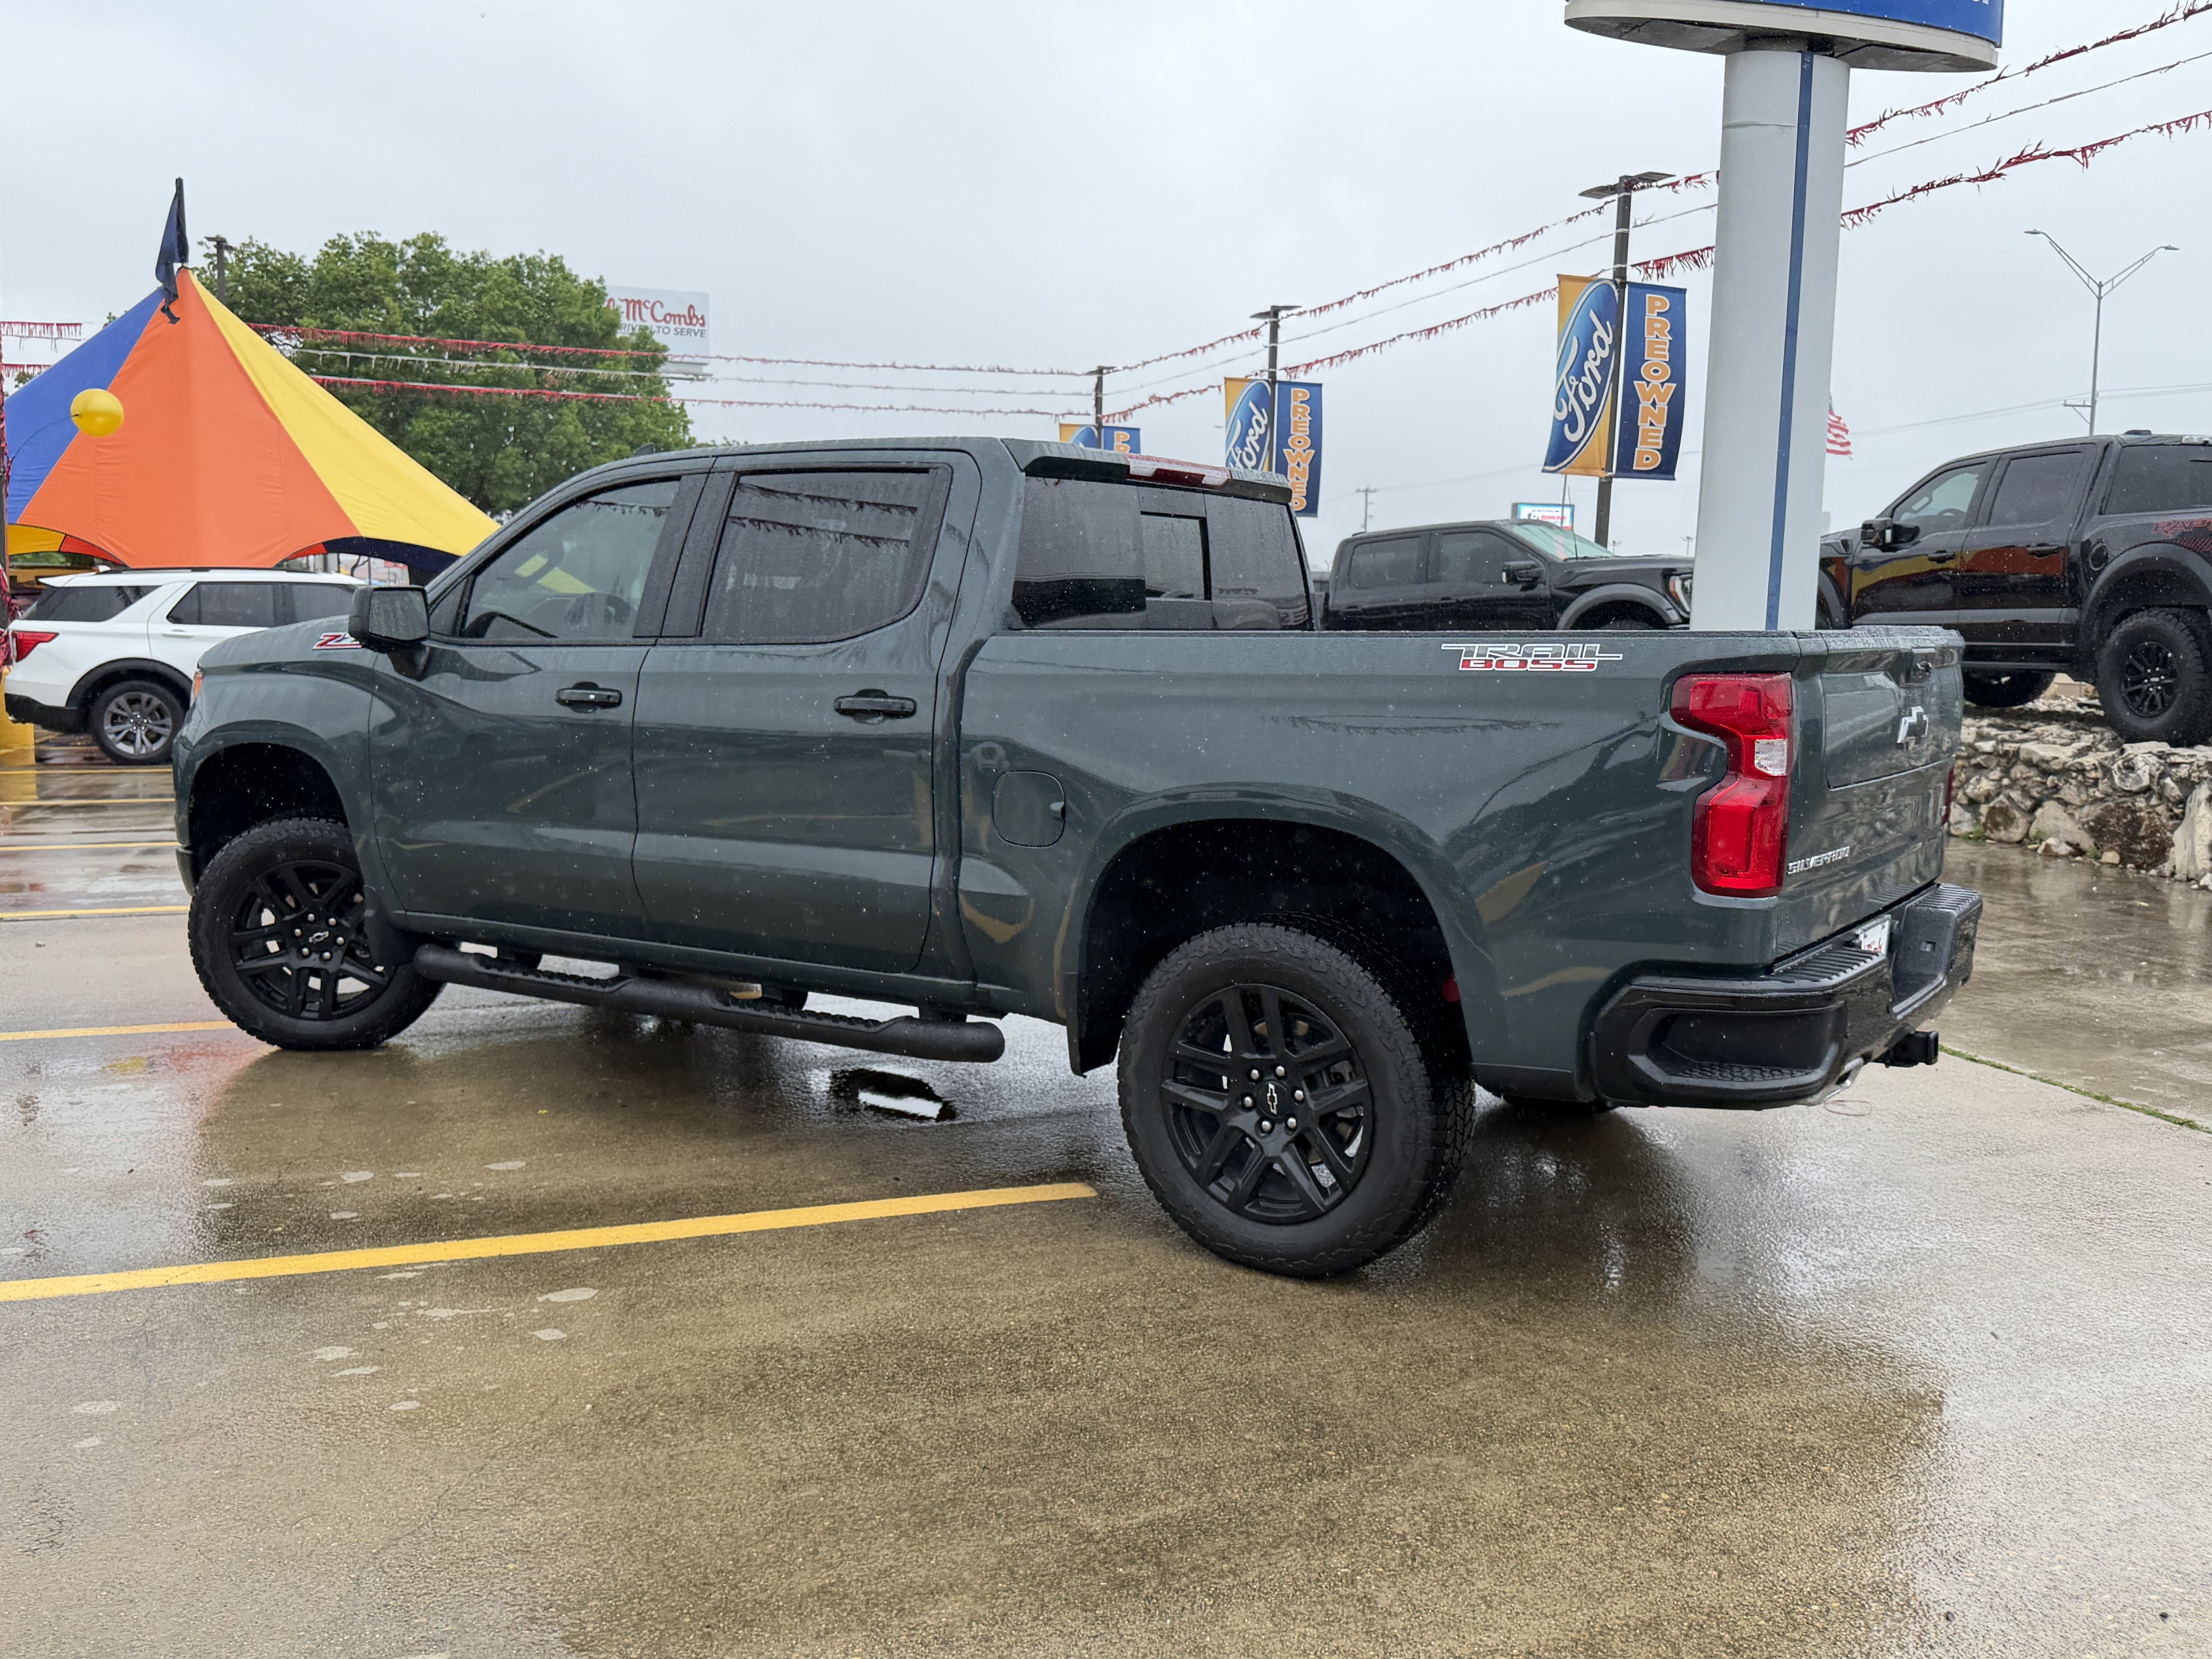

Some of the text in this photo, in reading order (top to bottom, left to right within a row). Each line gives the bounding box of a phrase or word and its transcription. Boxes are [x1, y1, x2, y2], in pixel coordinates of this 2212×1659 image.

[656, 325, 671, 335] TO
[673, 326, 706, 338] SERVE
[1554, 309, 1613, 442] Ford
[1632, 293, 1677, 471] PREOWNED
[1225, 400, 1268, 469] Ford
[1283, 388, 1315, 511] PREOWNED
[1441, 644, 1623, 660] TRAIL
[1459, 658, 1598, 672] BOSS
